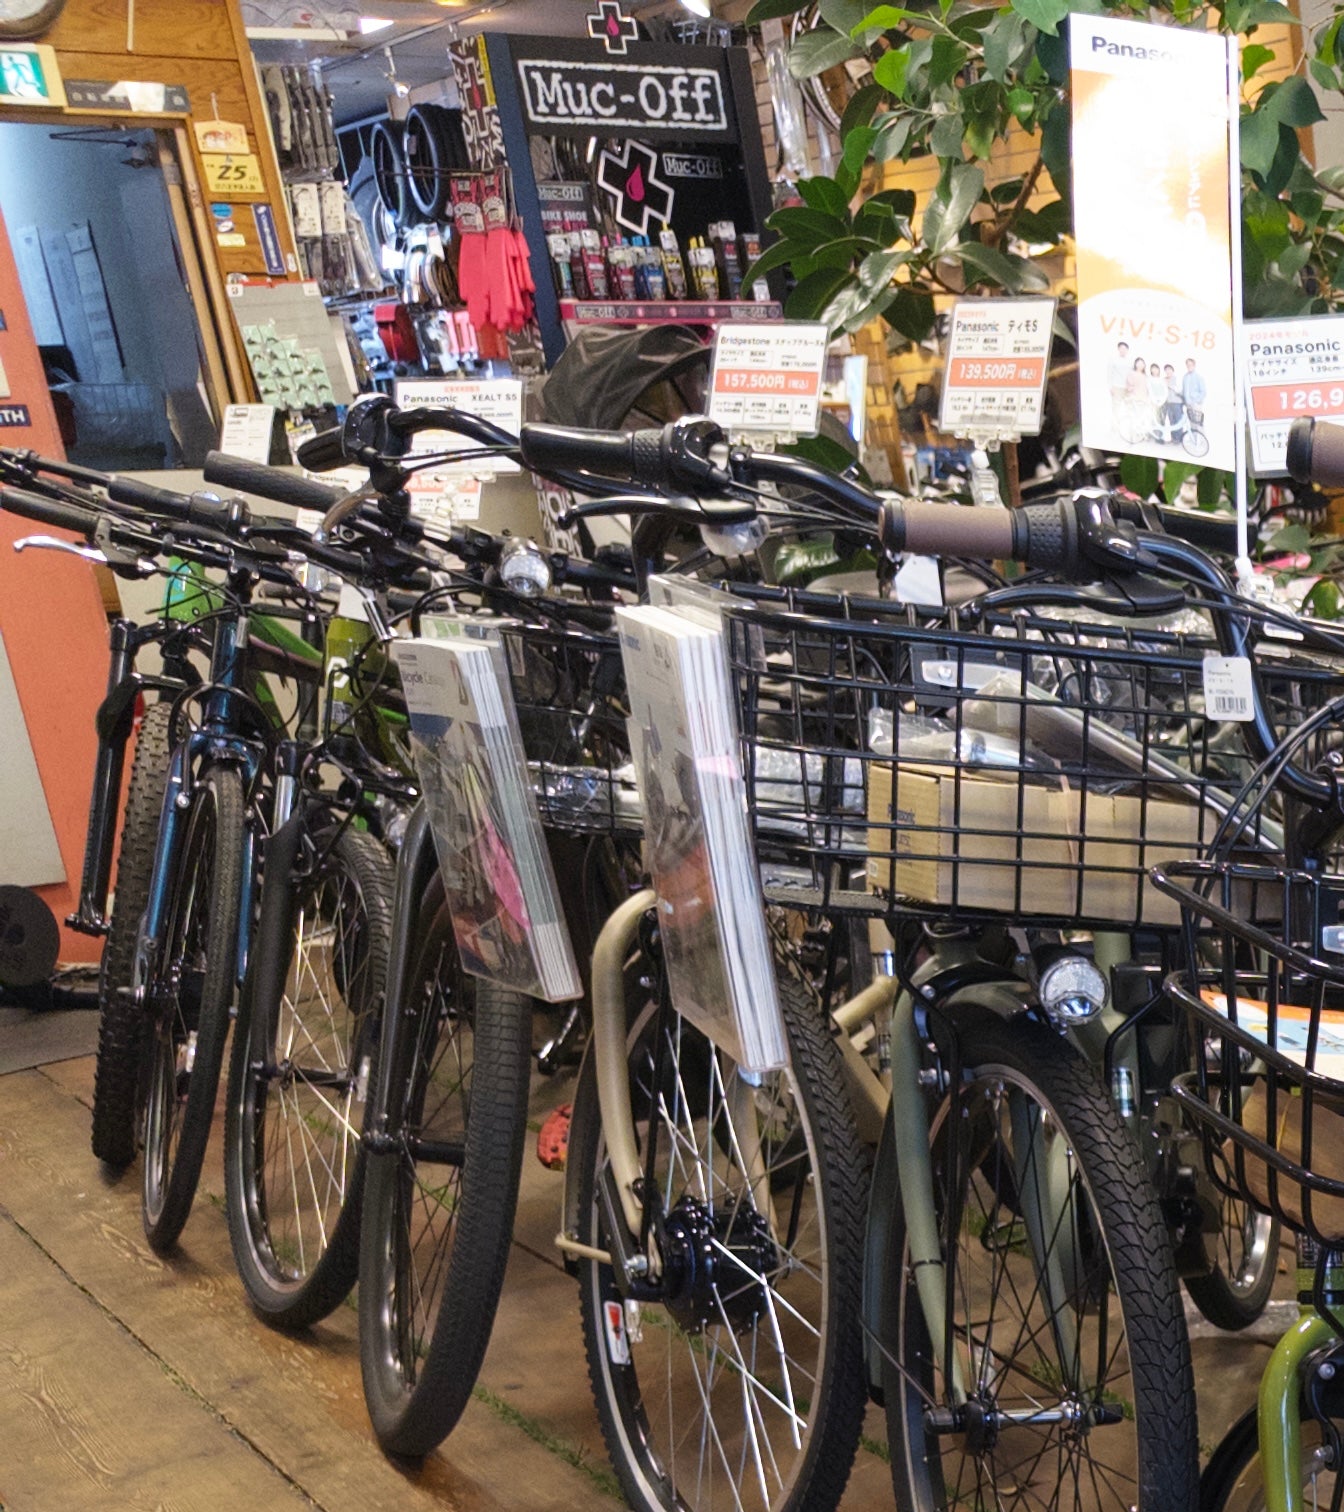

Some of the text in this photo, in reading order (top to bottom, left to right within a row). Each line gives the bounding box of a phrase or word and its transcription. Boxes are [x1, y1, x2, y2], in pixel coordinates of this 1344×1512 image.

[1091, 35, 1174, 62] Panaso
[530, 71, 714, 122] Muc-Off
[217, 164, 247, 181] 25
[666, 157, 721, 177] Muc-Off
[564, 211, 587, 221] SHOE
[956, 320, 999, 332] Panasonic
[720, 336, 770, 346] Bridgestone
[1250, 339, 1341, 356] Panasonic
[960, 363, 1016, 380] 139,500円
[724, 373, 785, 389] 157,500円
[403, 393, 518, 403] Panasonic XEALT S5
